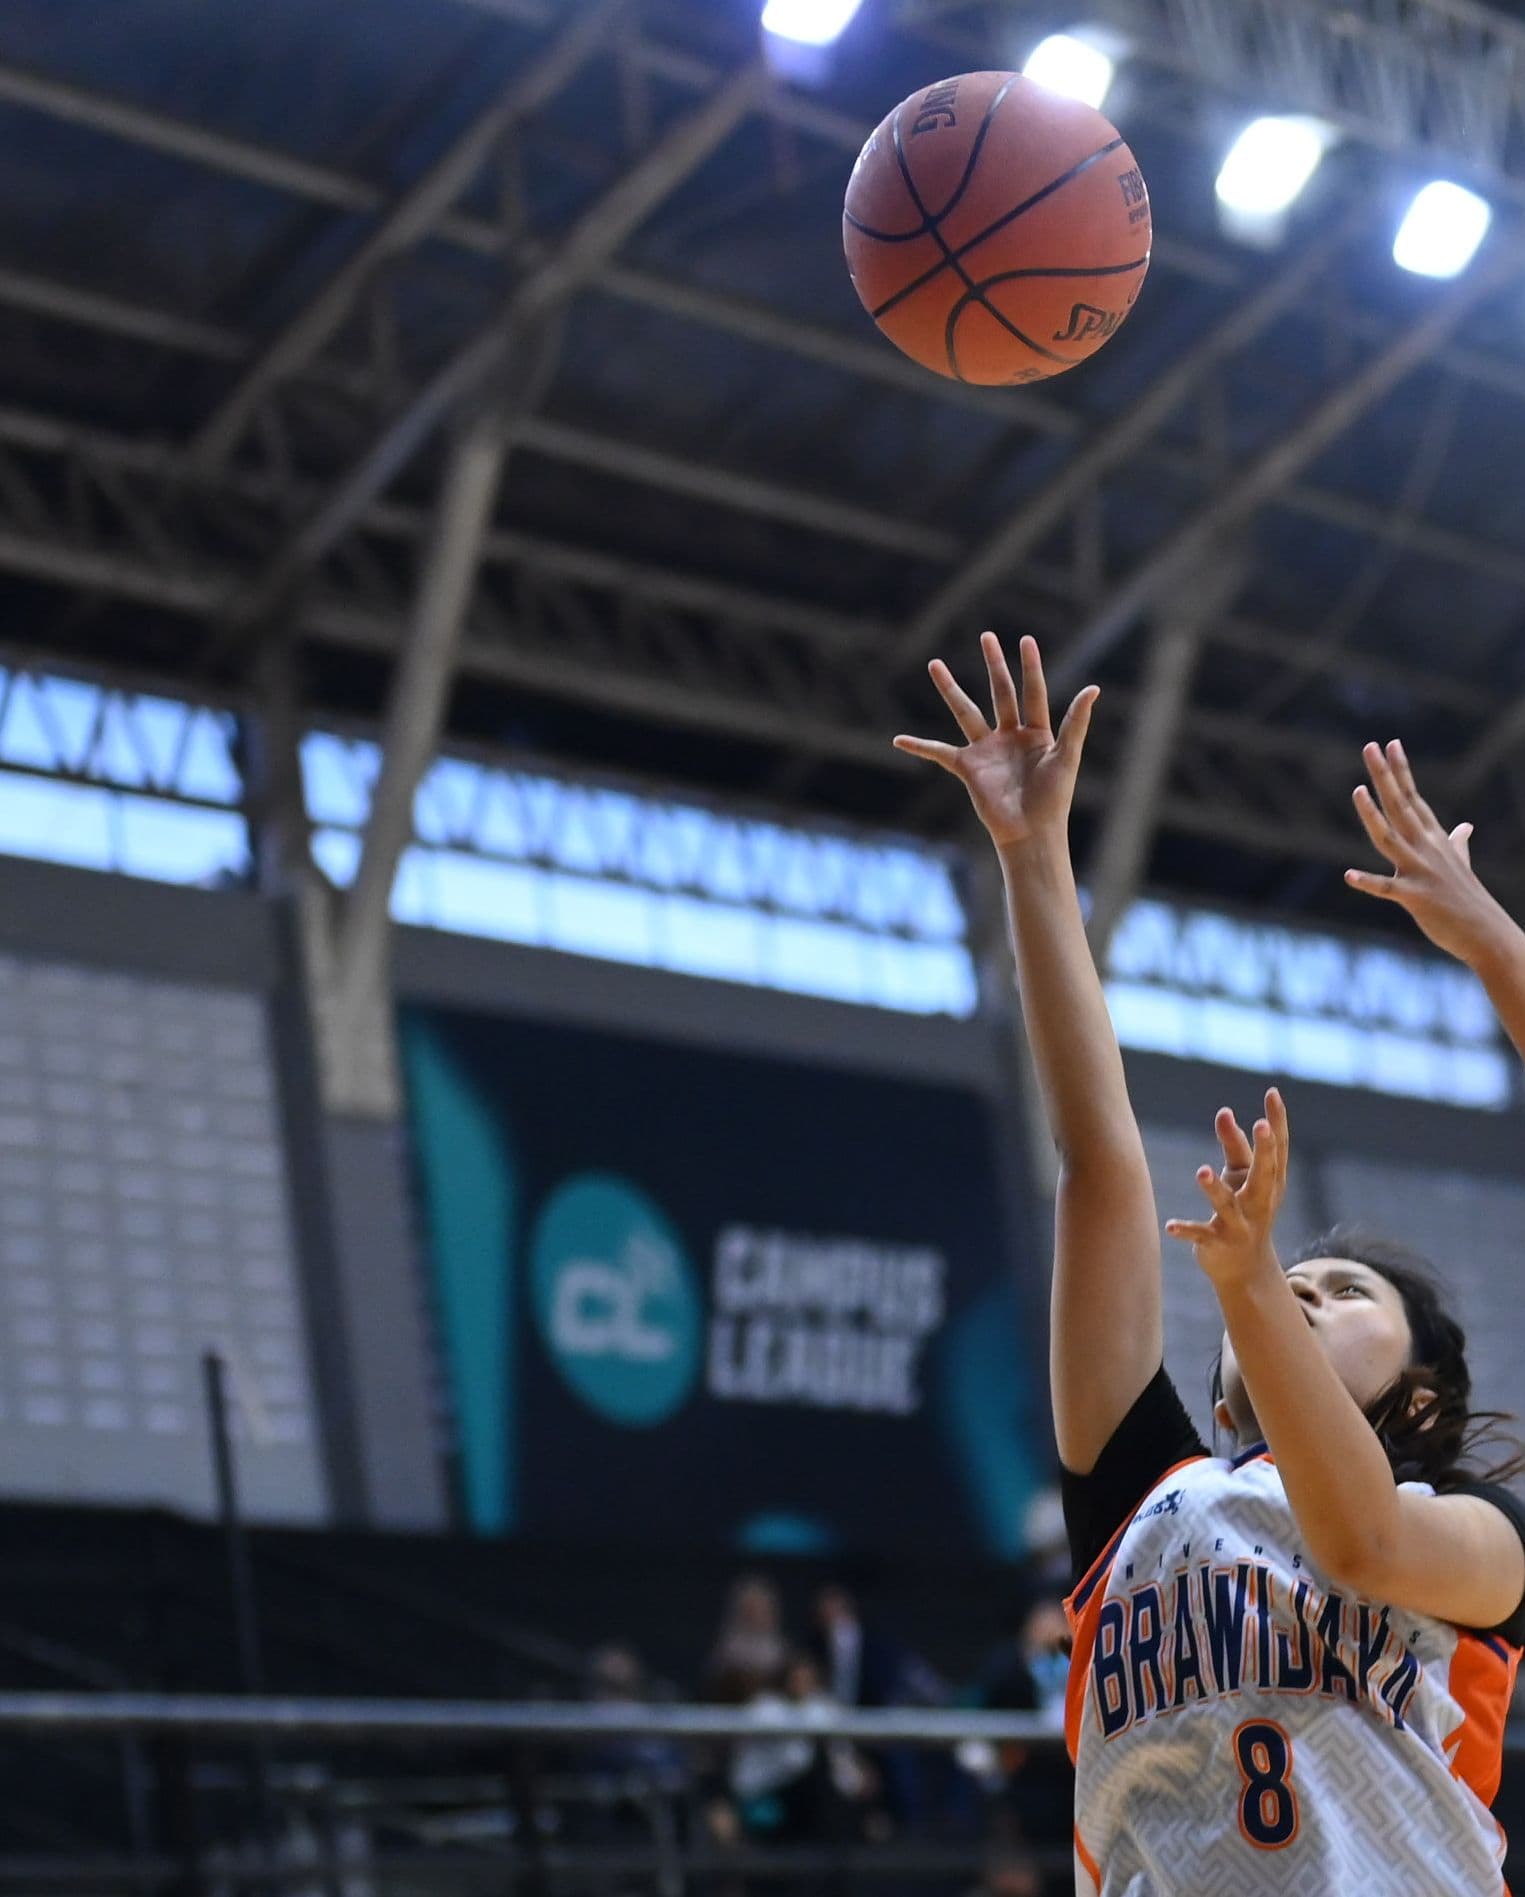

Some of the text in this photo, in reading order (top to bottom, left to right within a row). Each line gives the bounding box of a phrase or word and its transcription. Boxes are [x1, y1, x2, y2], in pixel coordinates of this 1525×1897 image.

[716, 1228, 948, 1337] CAMPUS
[708, 1312, 918, 1416] LEAGUE
[1090, 1557, 1424, 1745] BRAWIJAYA
[1231, 1717, 1300, 1850] 8
